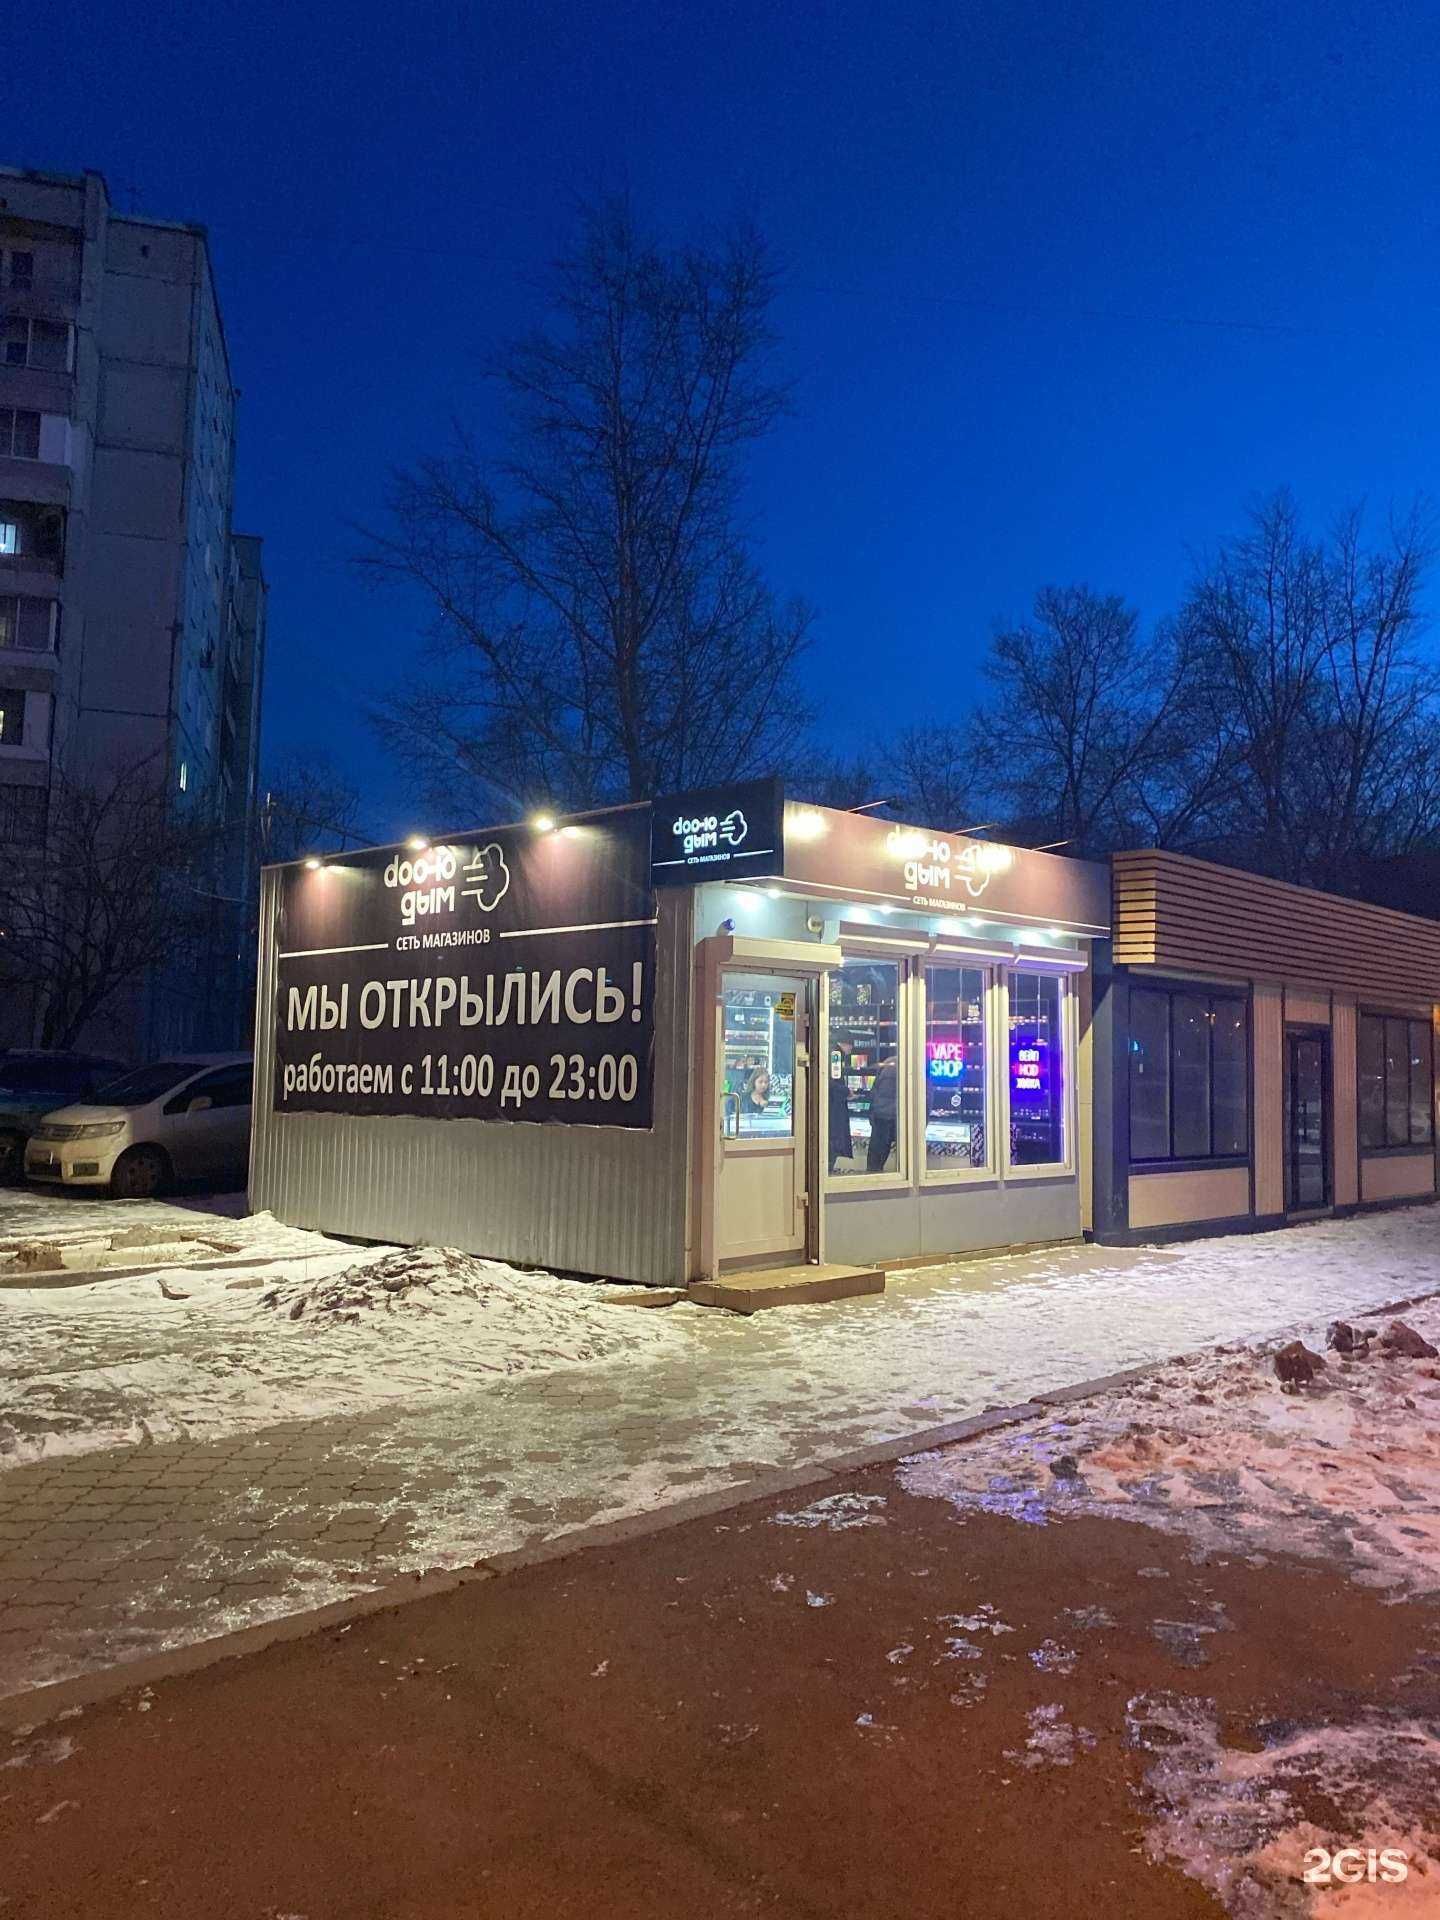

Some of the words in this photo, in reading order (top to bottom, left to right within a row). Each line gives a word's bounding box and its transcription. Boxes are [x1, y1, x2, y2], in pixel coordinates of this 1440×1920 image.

[396, 936, 421, 951] СЕТЬ
[422, 928, 491, 949] МАГАЗИНОВ
[287, 983, 349, 1032] МЫ
[359, 961, 643, 1030] ОТКРЫЛИСЬ!
[932, 1042, 963, 1060] VAPE
[283, 1052, 393, 1101] работаем
[401, 1063, 414, 1095] с
[420, 1054, 494, 1098] 11:00
[500, 1064, 540, 1108] до
[548, 1053, 638, 1101] 23:00
[930, 1060, 963, 1077] SHOP
